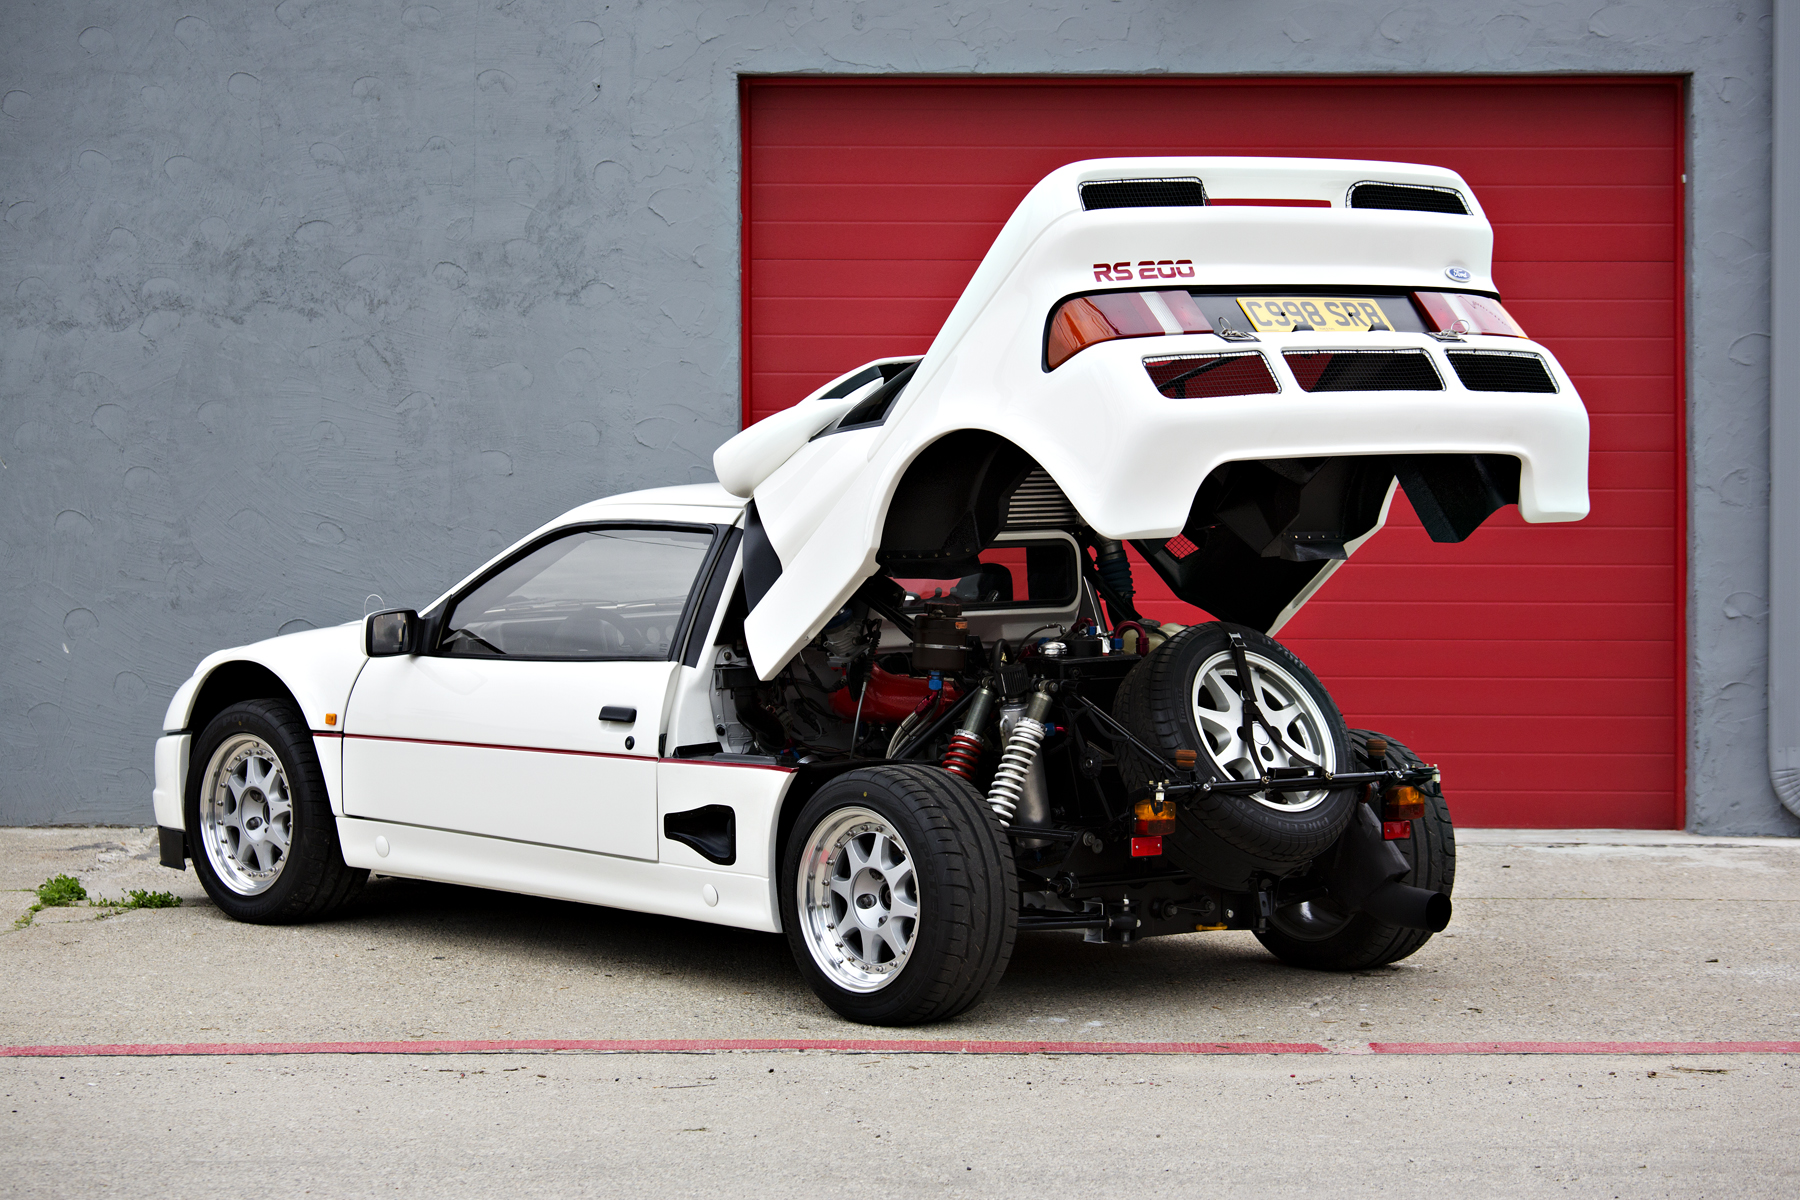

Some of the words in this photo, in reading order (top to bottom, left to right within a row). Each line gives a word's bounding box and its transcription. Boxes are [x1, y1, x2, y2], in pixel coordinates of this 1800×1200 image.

[1093, 261, 1133, 283] RS
[1137, 258, 1195, 280] 200
[1246, 301, 1327, 327] C998
[1323, 301, 1384, 327] SRB
[1277, 816, 1330, 833] PIRELLI
